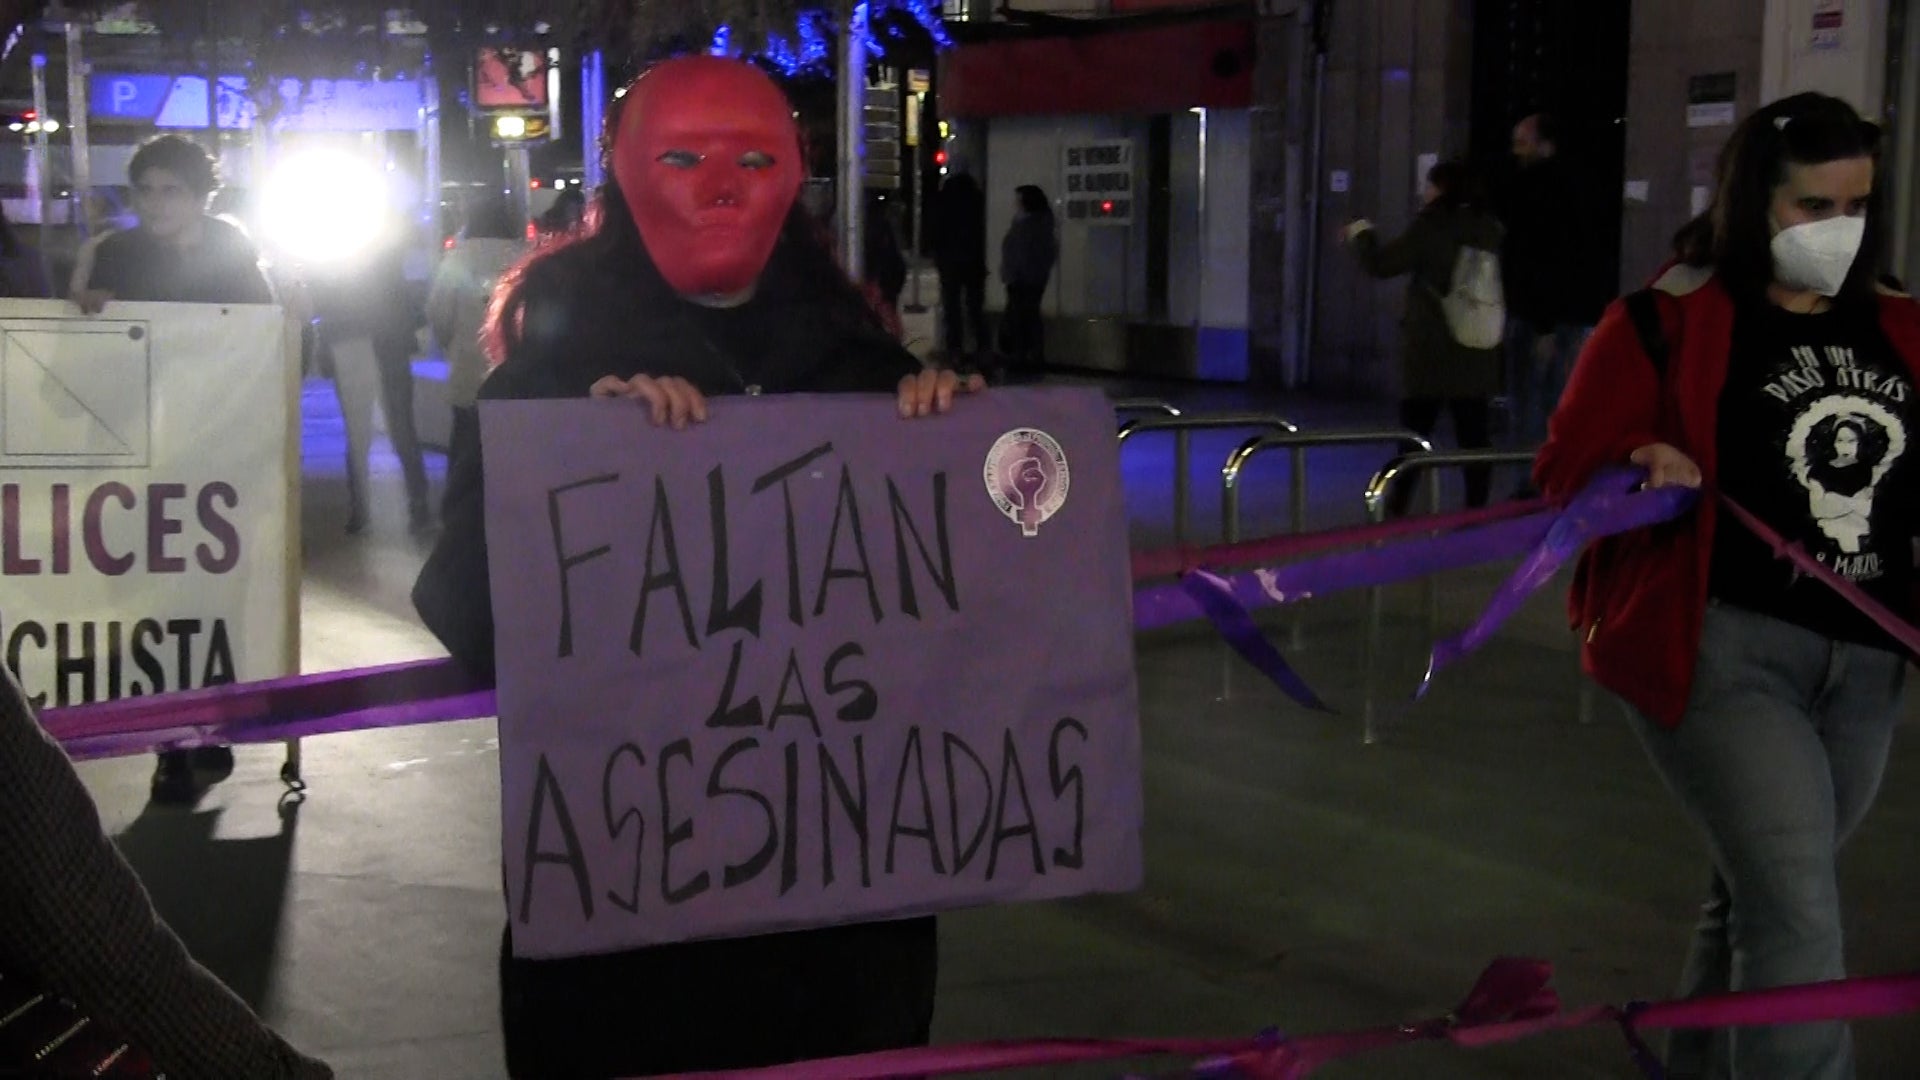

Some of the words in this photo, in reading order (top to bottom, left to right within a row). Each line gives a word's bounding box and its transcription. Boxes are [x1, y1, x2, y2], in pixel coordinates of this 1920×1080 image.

[112, 80, 138, 113] P
[1762, 367, 1825, 403] PASO
[1, 480, 240, 577] LICES
[547, 441, 960, 658] FALTAN
[706, 640, 879, 737] LAS
[518, 716, 1089, 924] ASESINADAS
